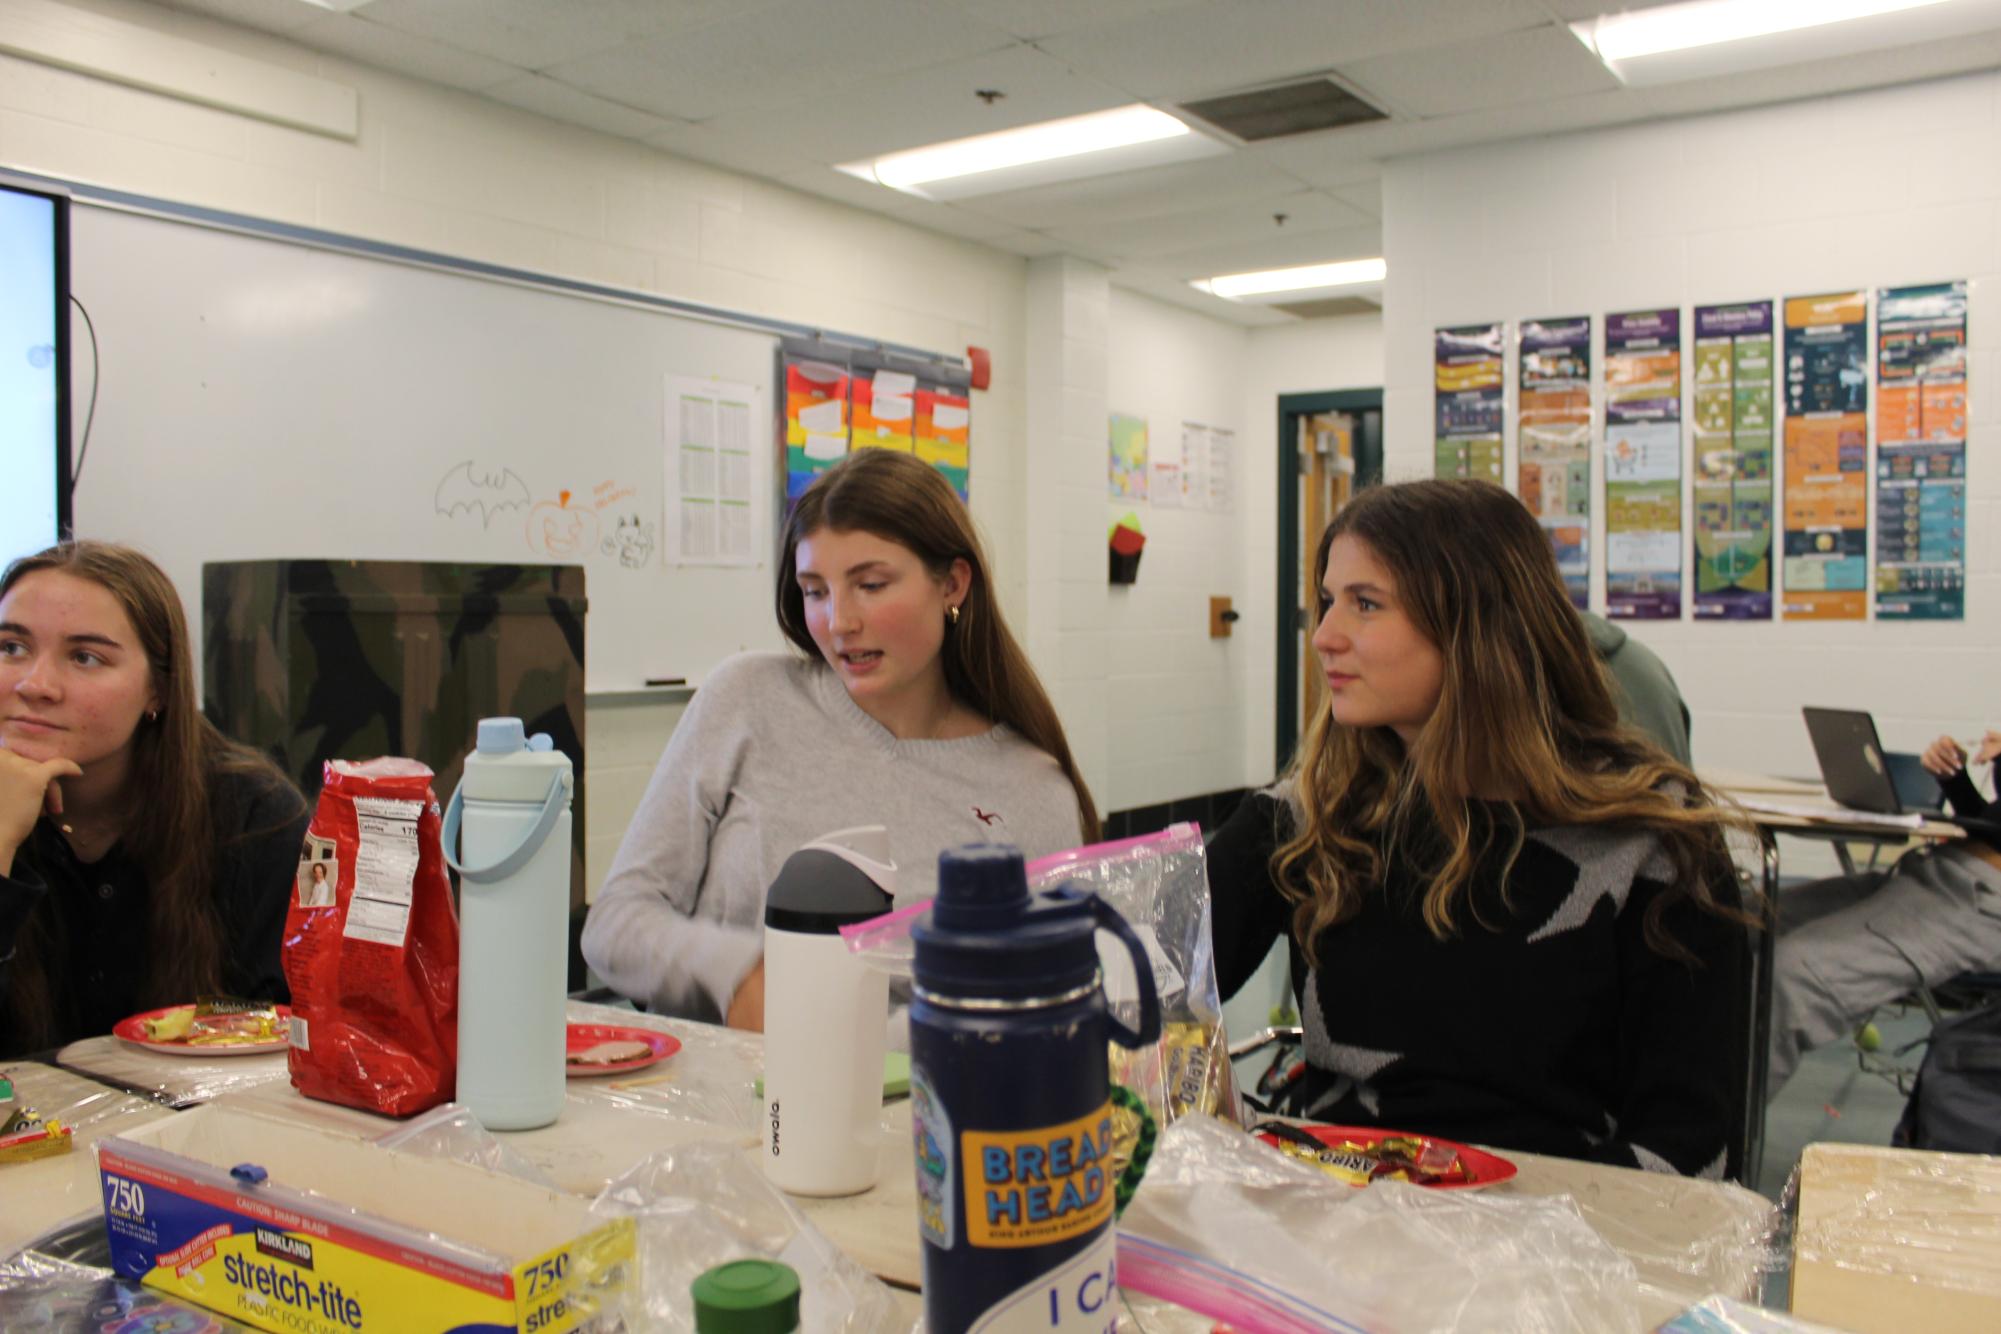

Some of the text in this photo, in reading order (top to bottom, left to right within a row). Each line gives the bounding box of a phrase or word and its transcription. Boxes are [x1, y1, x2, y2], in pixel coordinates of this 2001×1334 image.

[1180, 1046, 1203, 1104] HARIBO
[770, 1100, 780, 1156] owala
[982, 1118, 1111, 1184] BREAD
[1319, 1152, 1376, 1172] ARIBO
[107, 1175, 145, 1217] 750
[274, 1209, 300, 1226] SHARP
[302, 1218, 329, 1237] BLADE
[985, 1166, 1104, 1227] HEAD
[257, 1229, 311, 1260] KIRKLAND
[224, 1252, 362, 1329] stretch-tite
